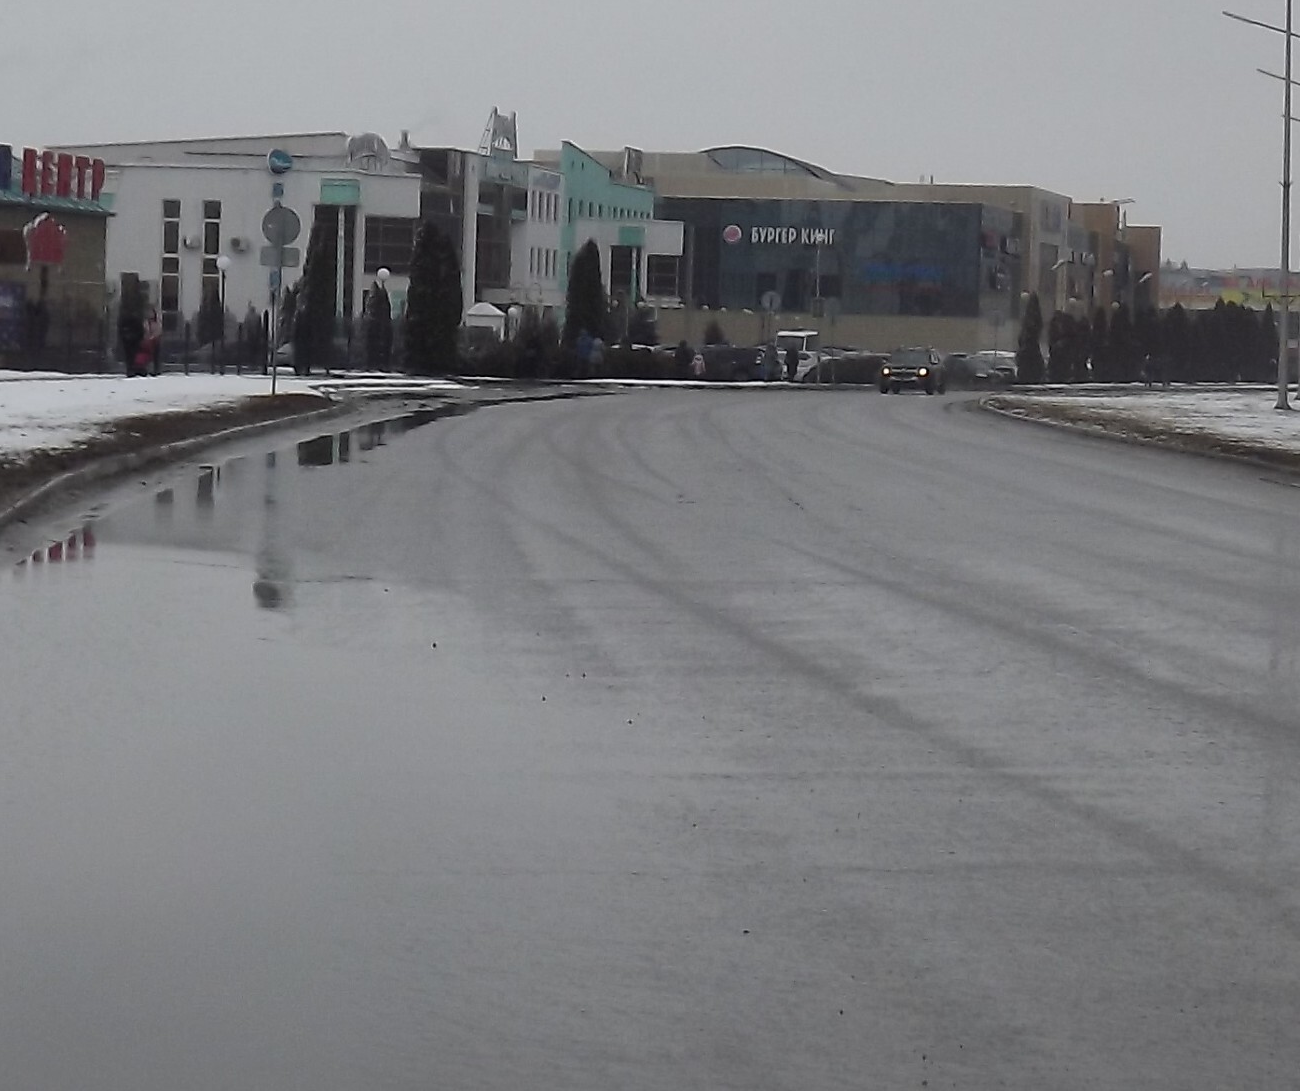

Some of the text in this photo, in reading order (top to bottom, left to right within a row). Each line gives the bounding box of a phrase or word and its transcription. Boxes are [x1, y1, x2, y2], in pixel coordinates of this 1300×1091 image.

[22, 147, 105, 202] ЦЕНТР
[751, 226, 836, 245] БУРГЕР КИНГ
